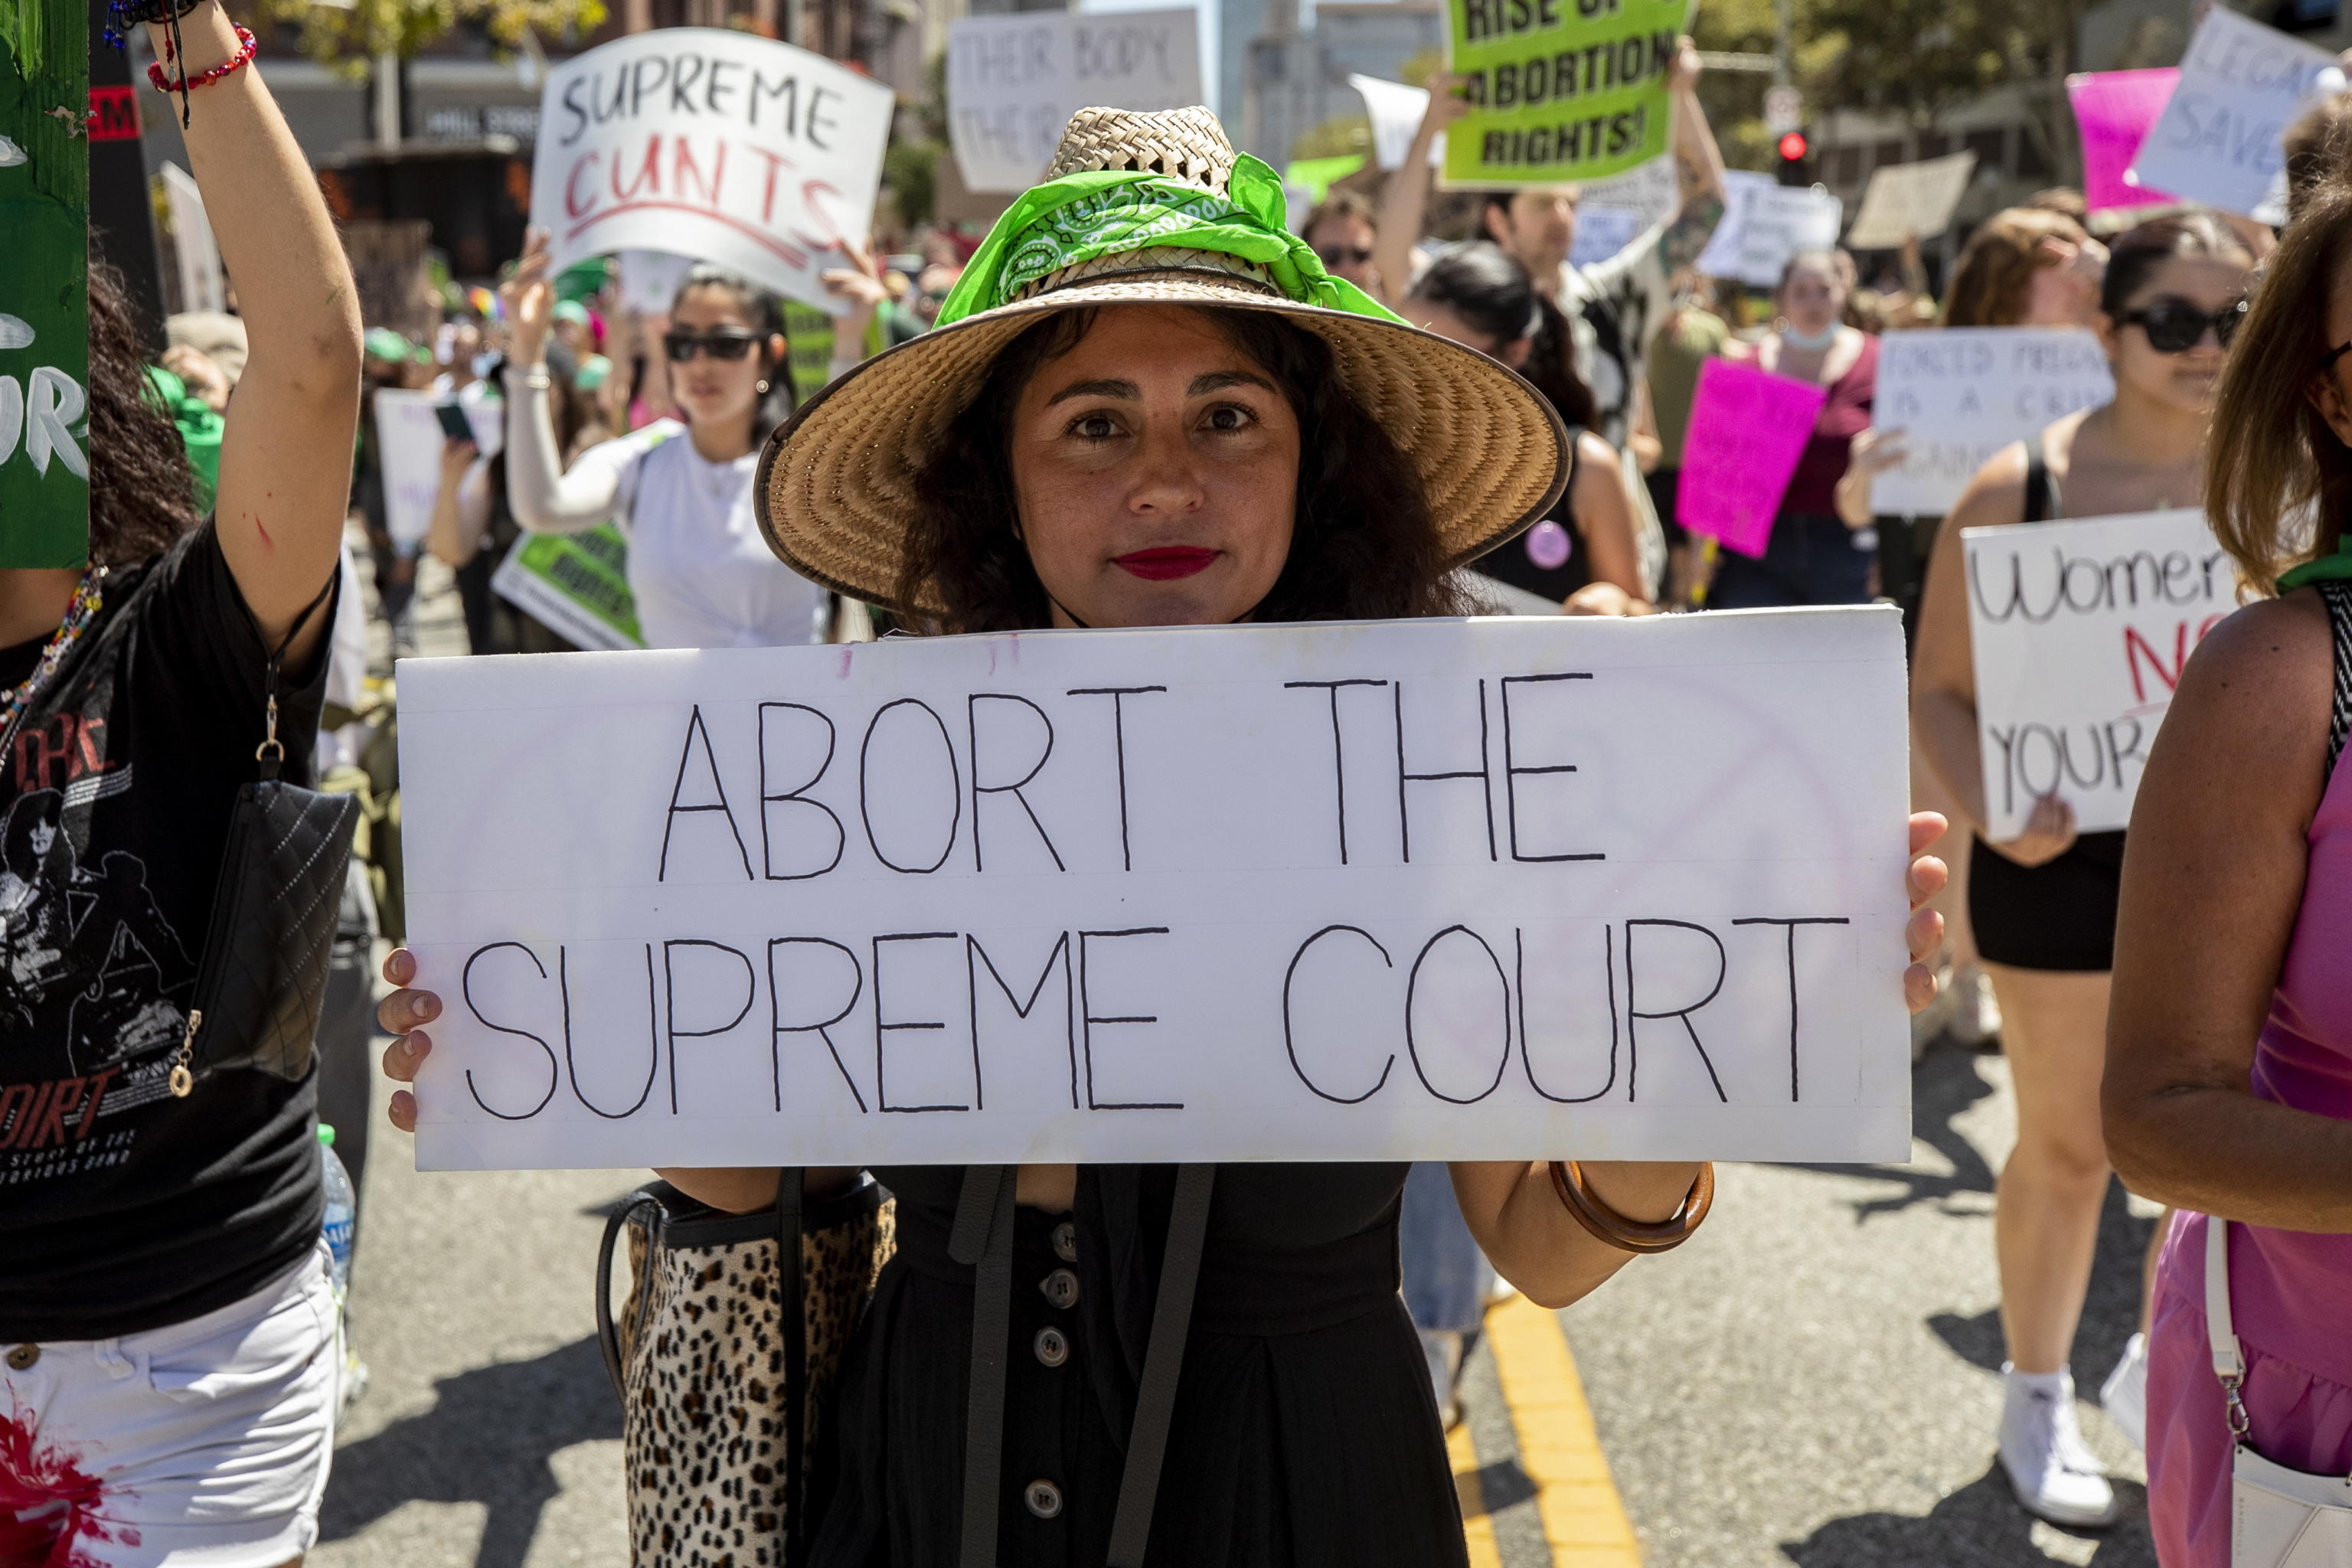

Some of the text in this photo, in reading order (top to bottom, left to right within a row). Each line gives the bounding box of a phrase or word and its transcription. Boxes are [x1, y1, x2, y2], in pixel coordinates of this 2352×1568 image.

[558, 52, 845, 150] SUPREME
[1073, 24, 1175, 83] BODY
[1465, 29, 1674, 109] ABORTION
[1481, 102, 1645, 165] RIGHTS!
[565, 132, 844, 253] CUNTS
[2123, 612, 2230, 704] N
[659, 673, 1605, 881] ABORT THE
[1988, 714, 2148, 815] YOUR
[463, 918, 1849, 1119] SUPREME COURT
[0, 1065, 122, 1149] DIRT
